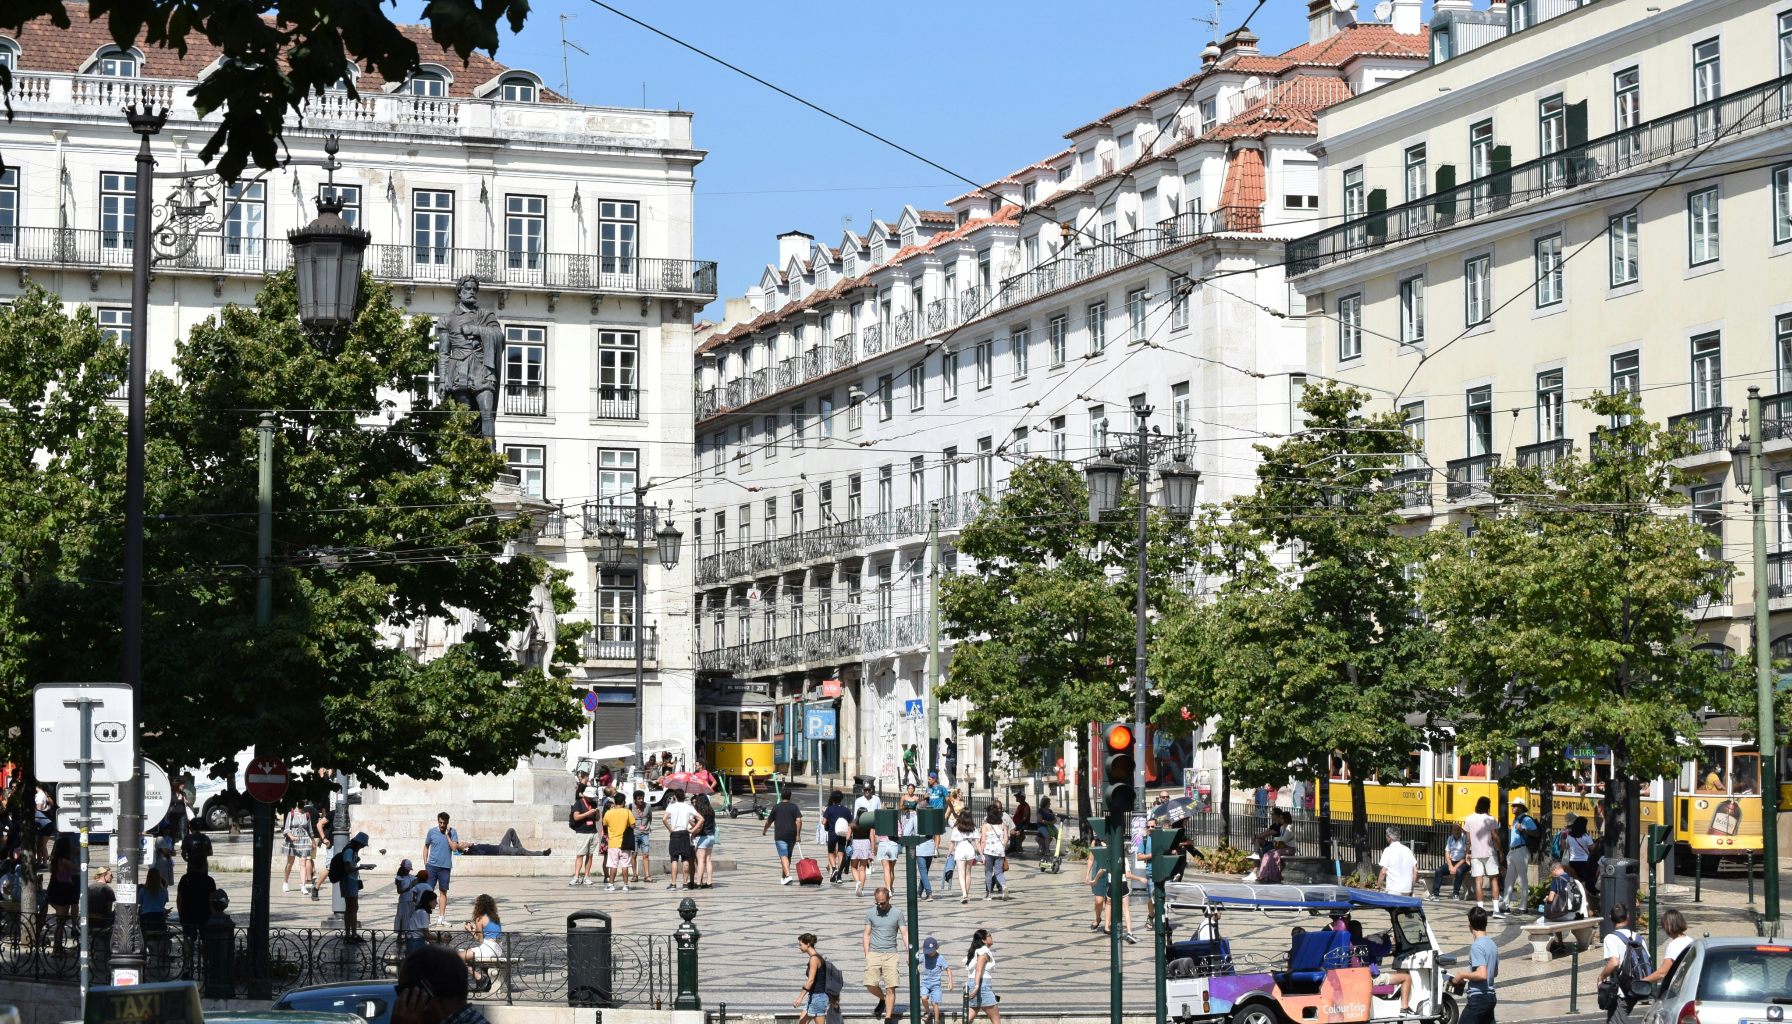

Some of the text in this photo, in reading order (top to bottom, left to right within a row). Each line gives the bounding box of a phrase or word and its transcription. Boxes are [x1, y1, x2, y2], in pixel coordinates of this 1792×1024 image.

[809, 716, 822, 735] P
[1553, 800, 1561, 809] DE
[1561, 801, 1590, 811] PORTUGAL
[110, 994, 160, 1019] TAXI
[1323, 1003, 1366, 1016] ColourTrip
